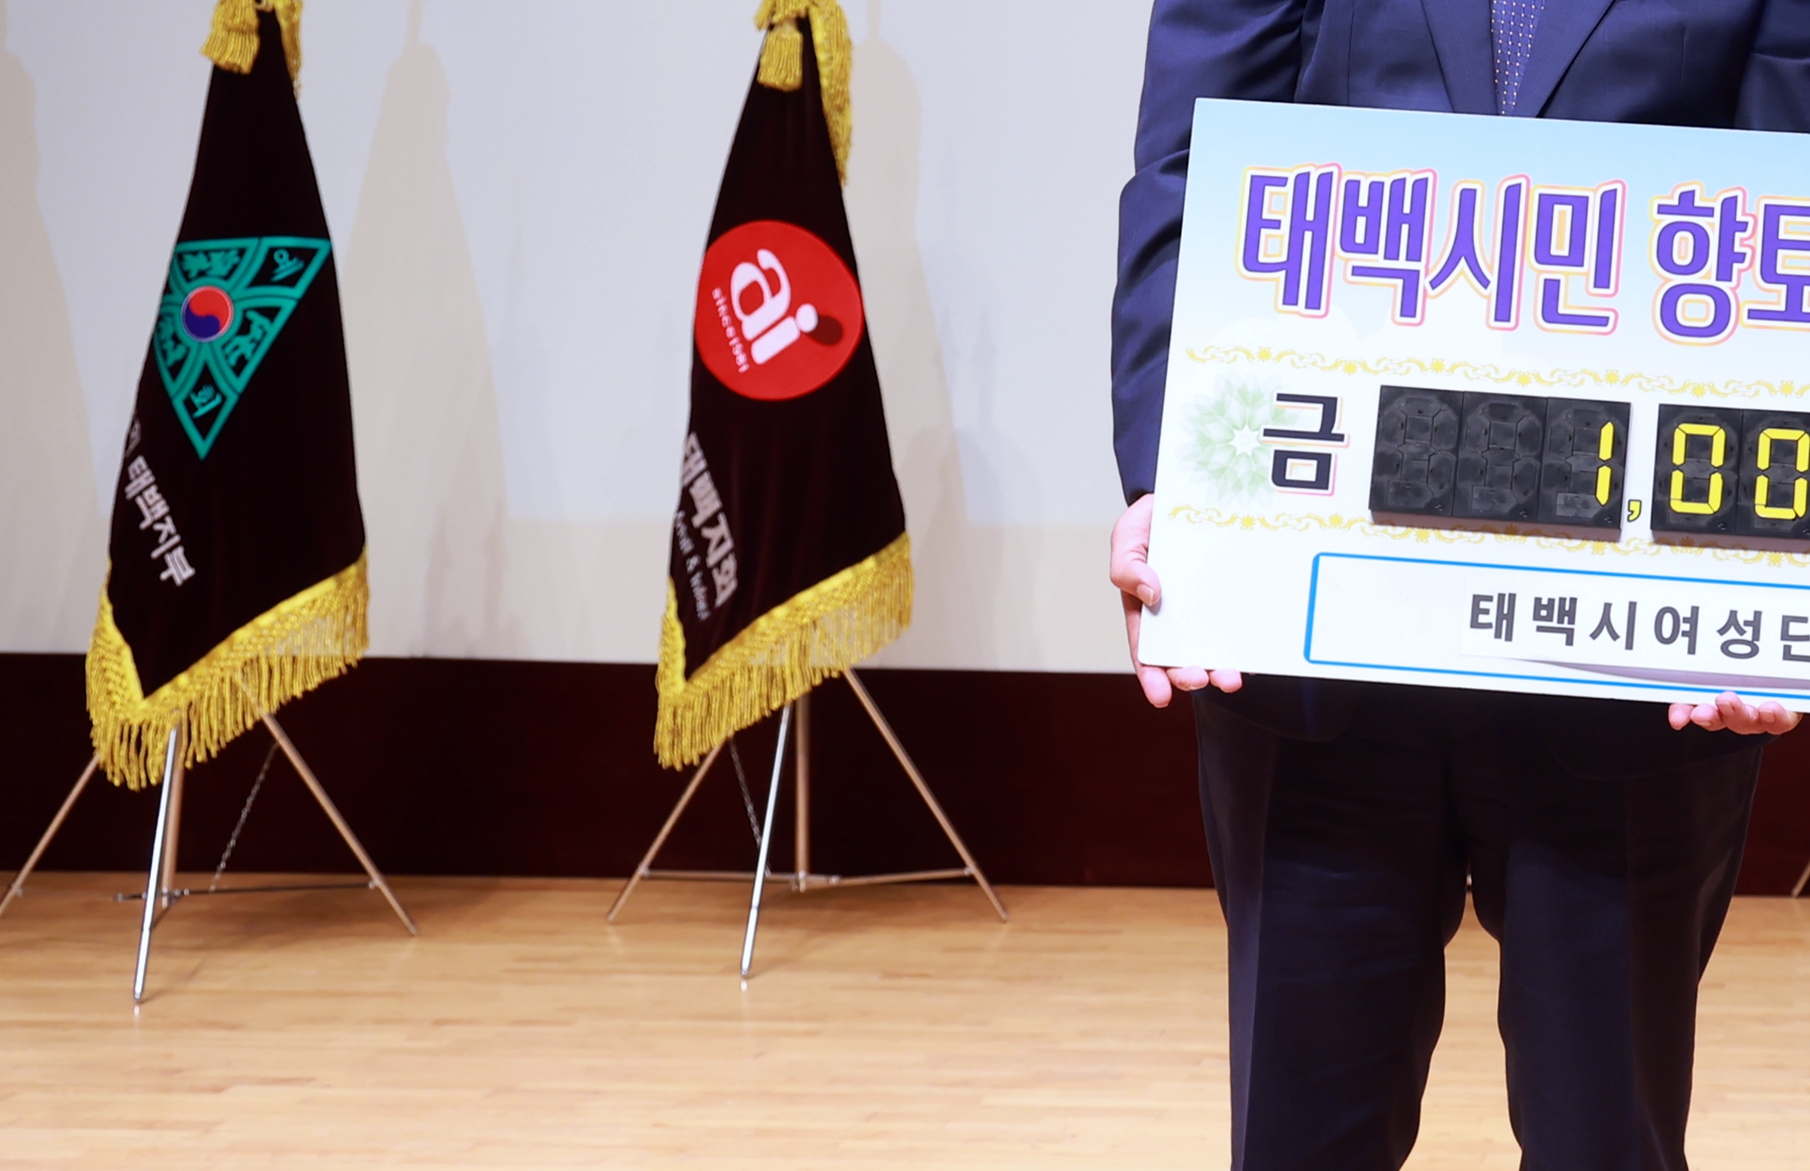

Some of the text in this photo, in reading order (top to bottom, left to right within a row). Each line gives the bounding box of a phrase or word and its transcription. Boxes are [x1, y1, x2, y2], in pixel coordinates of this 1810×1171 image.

[1238, 165, 1624, 333] 태백시민
[1262, 392, 1348, 495] 금
[124, 455, 196, 587] 태백지부
